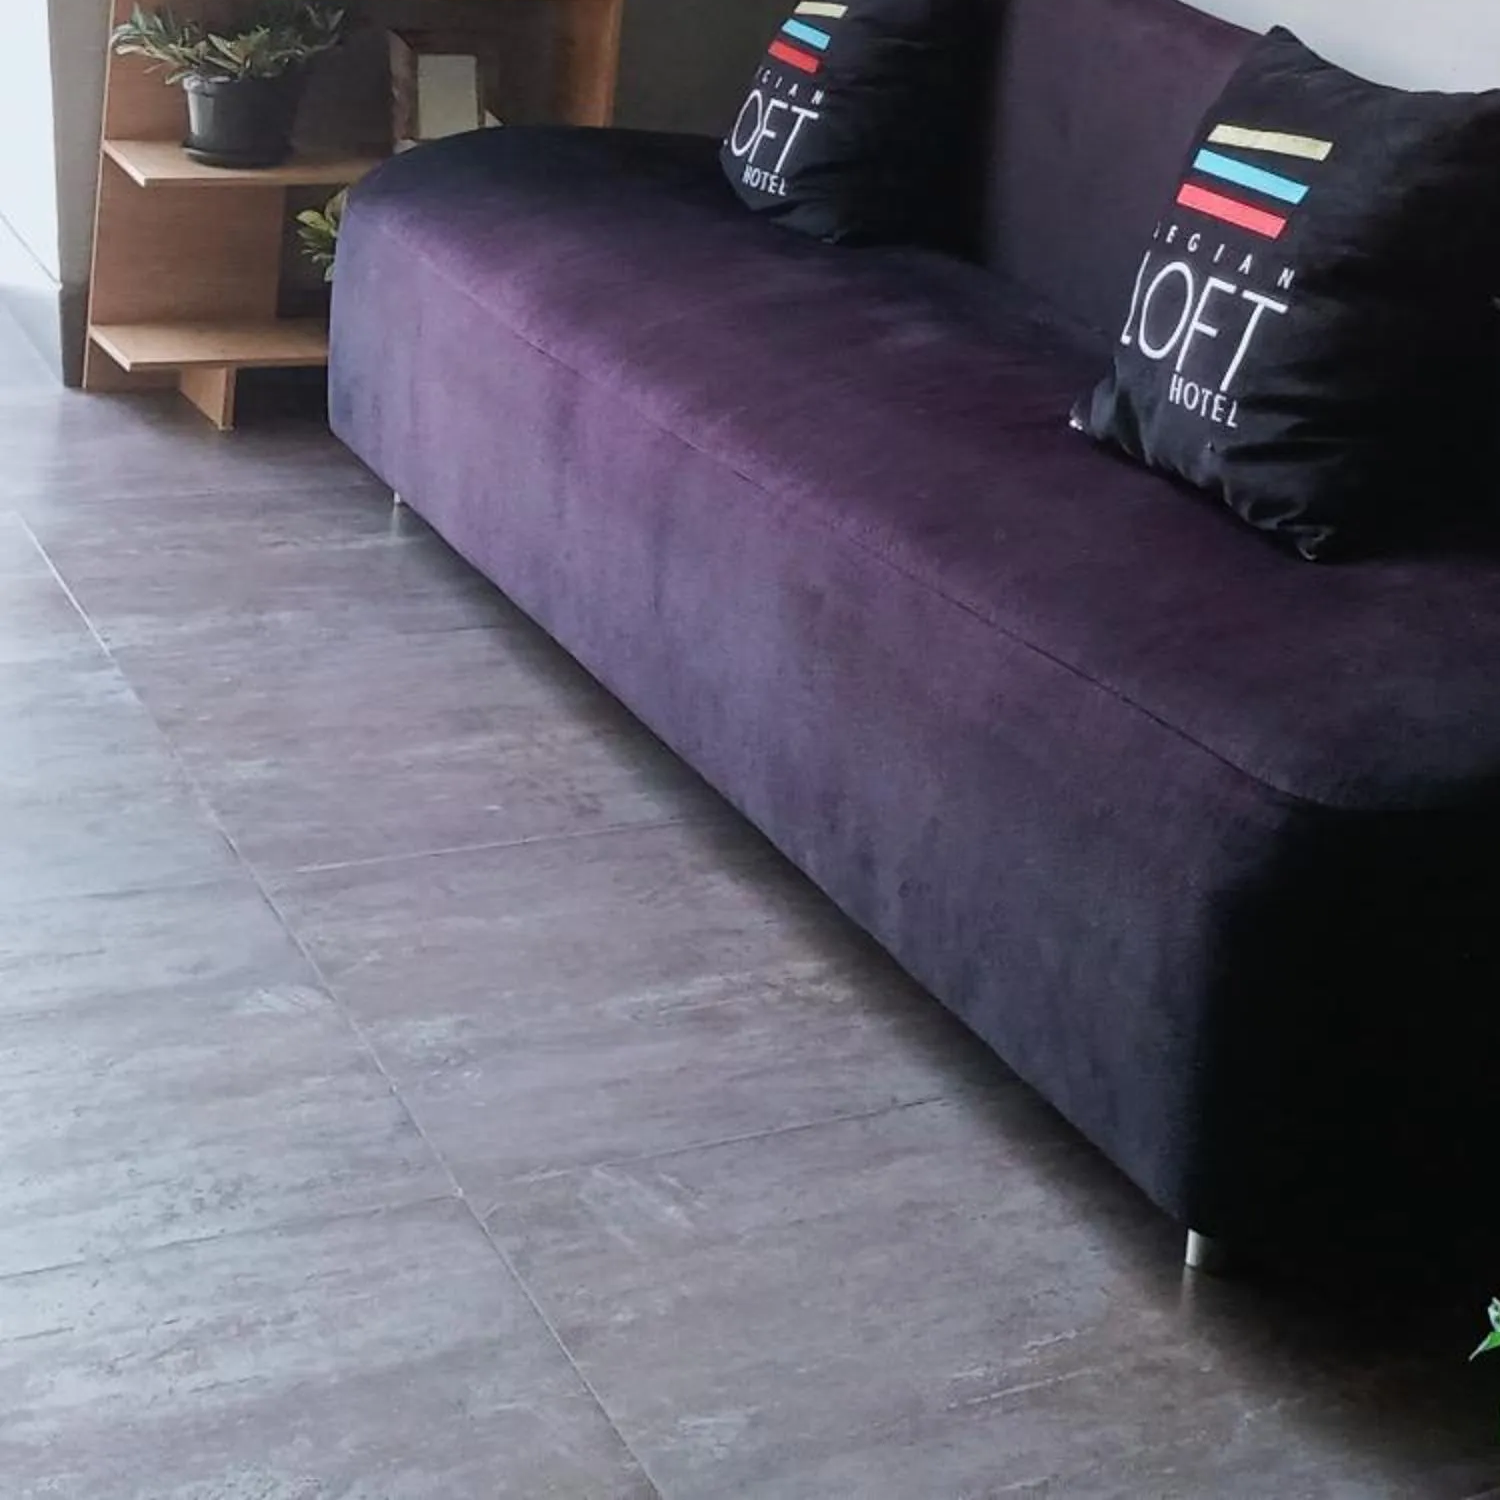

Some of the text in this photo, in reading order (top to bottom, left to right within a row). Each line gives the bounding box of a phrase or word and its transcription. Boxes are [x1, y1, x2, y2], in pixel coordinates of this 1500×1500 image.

[755, 65, 825, 106] GIAN
[723, 88, 820, 174] OFT
[742, 164, 788, 197] HOTEL
[1168, 372, 1239, 429] HOTEL
